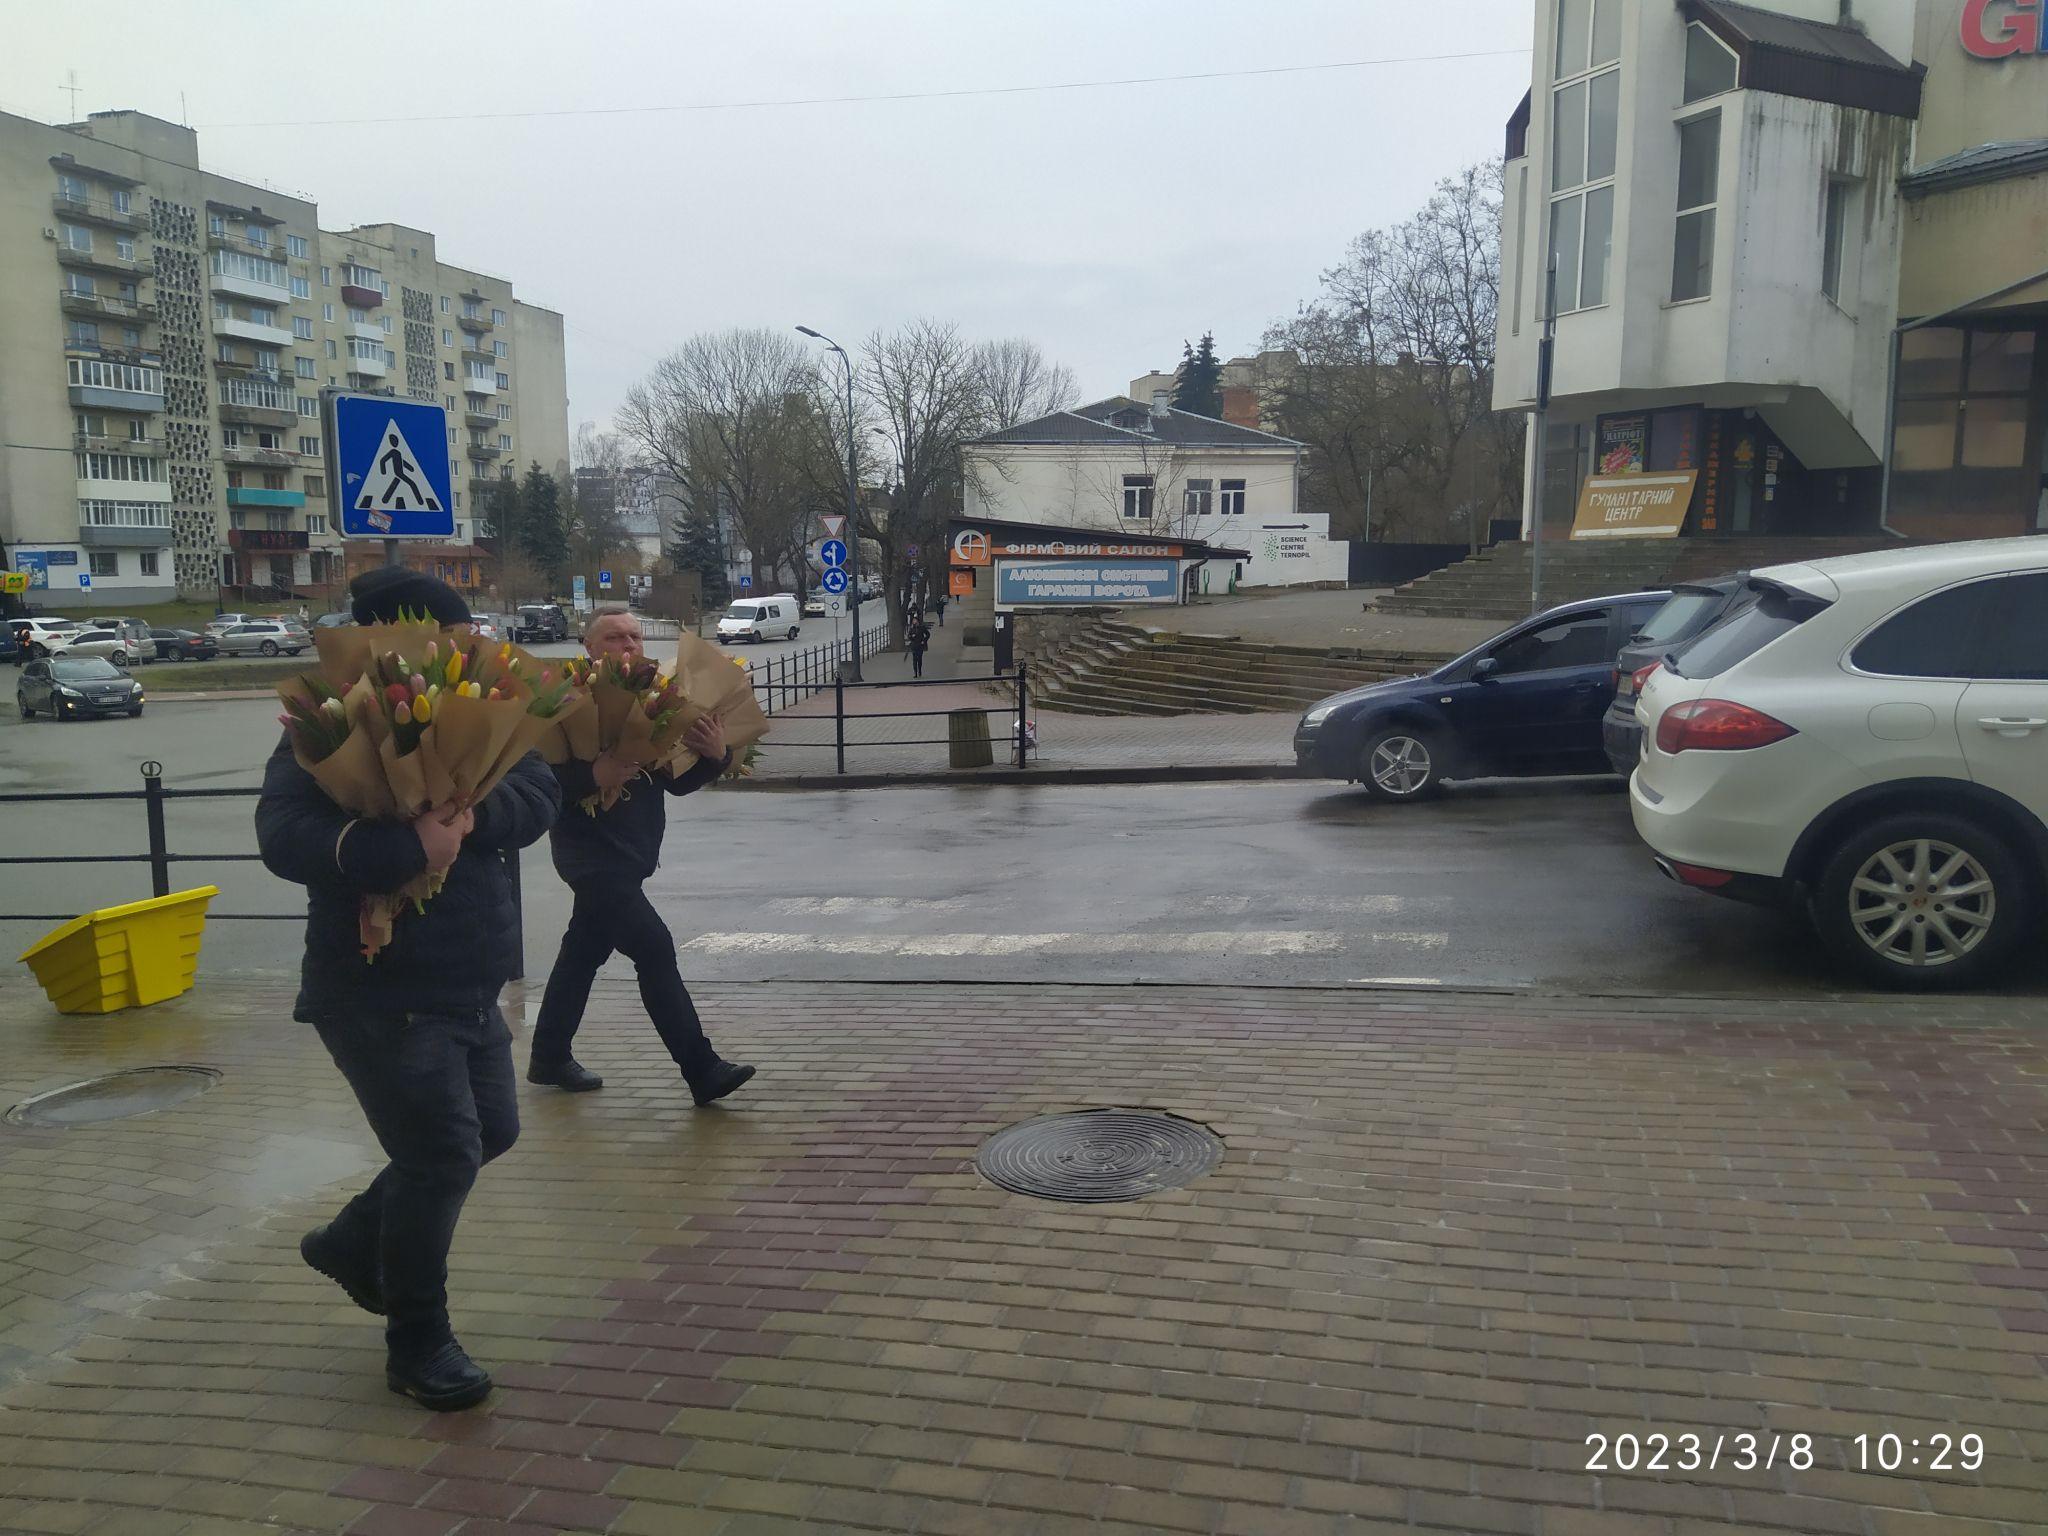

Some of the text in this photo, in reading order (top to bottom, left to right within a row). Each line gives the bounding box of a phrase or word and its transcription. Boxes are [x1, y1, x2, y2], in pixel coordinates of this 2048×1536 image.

[1589, 487, 1675, 507] ГУМАНІТАРНИЙ
[1605, 506, 1643, 522] ЦЕНТР
[1107, 545, 1169, 556] САЛОН
[1094, 584, 1150, 597] ВОРОТА
